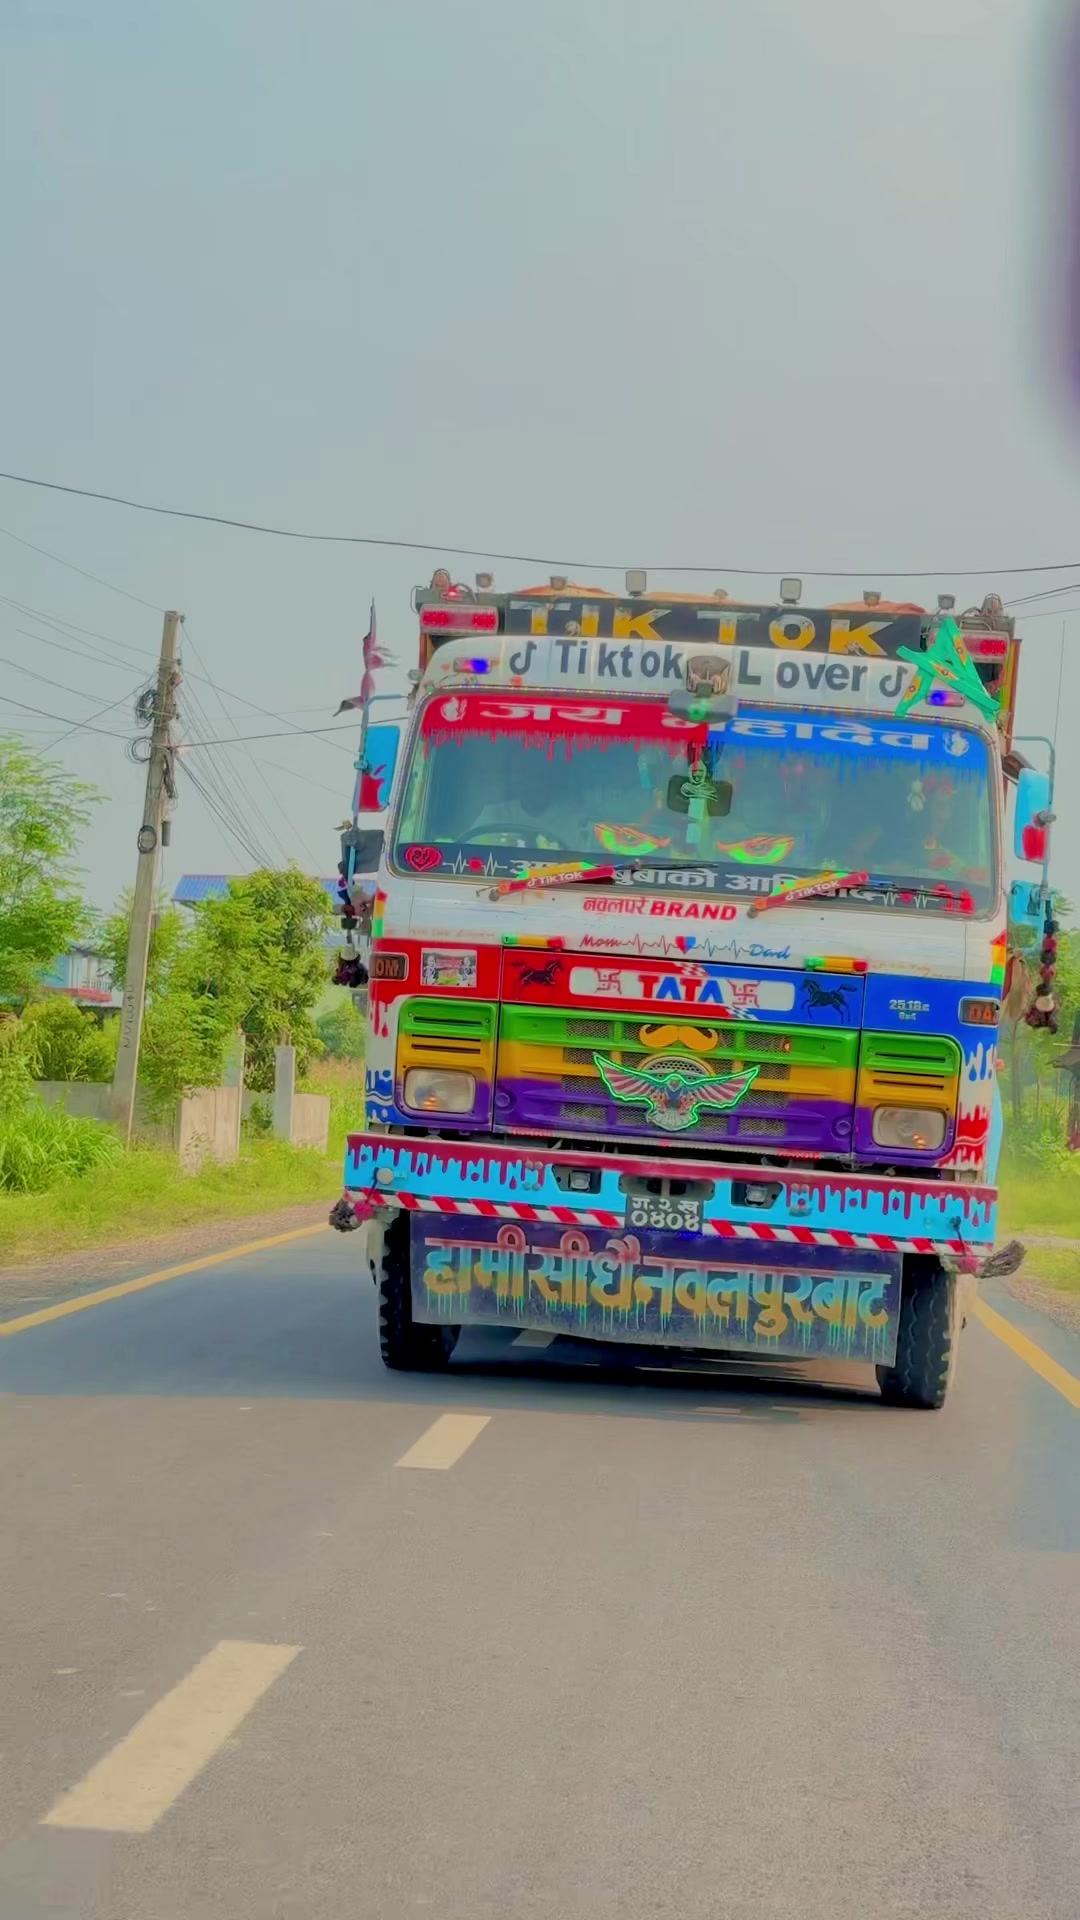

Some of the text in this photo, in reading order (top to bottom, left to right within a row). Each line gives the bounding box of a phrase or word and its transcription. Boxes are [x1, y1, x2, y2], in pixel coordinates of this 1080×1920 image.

[509, 600, 894, 657] TIK TOK
[478, 701, 631, 725] जय
[650, 900, 737, 921] BRAND
[579, 934, 621, 948] Mom
[750, 943, 791, 960] Dad
[638, 974, 724, 1004] TATA
